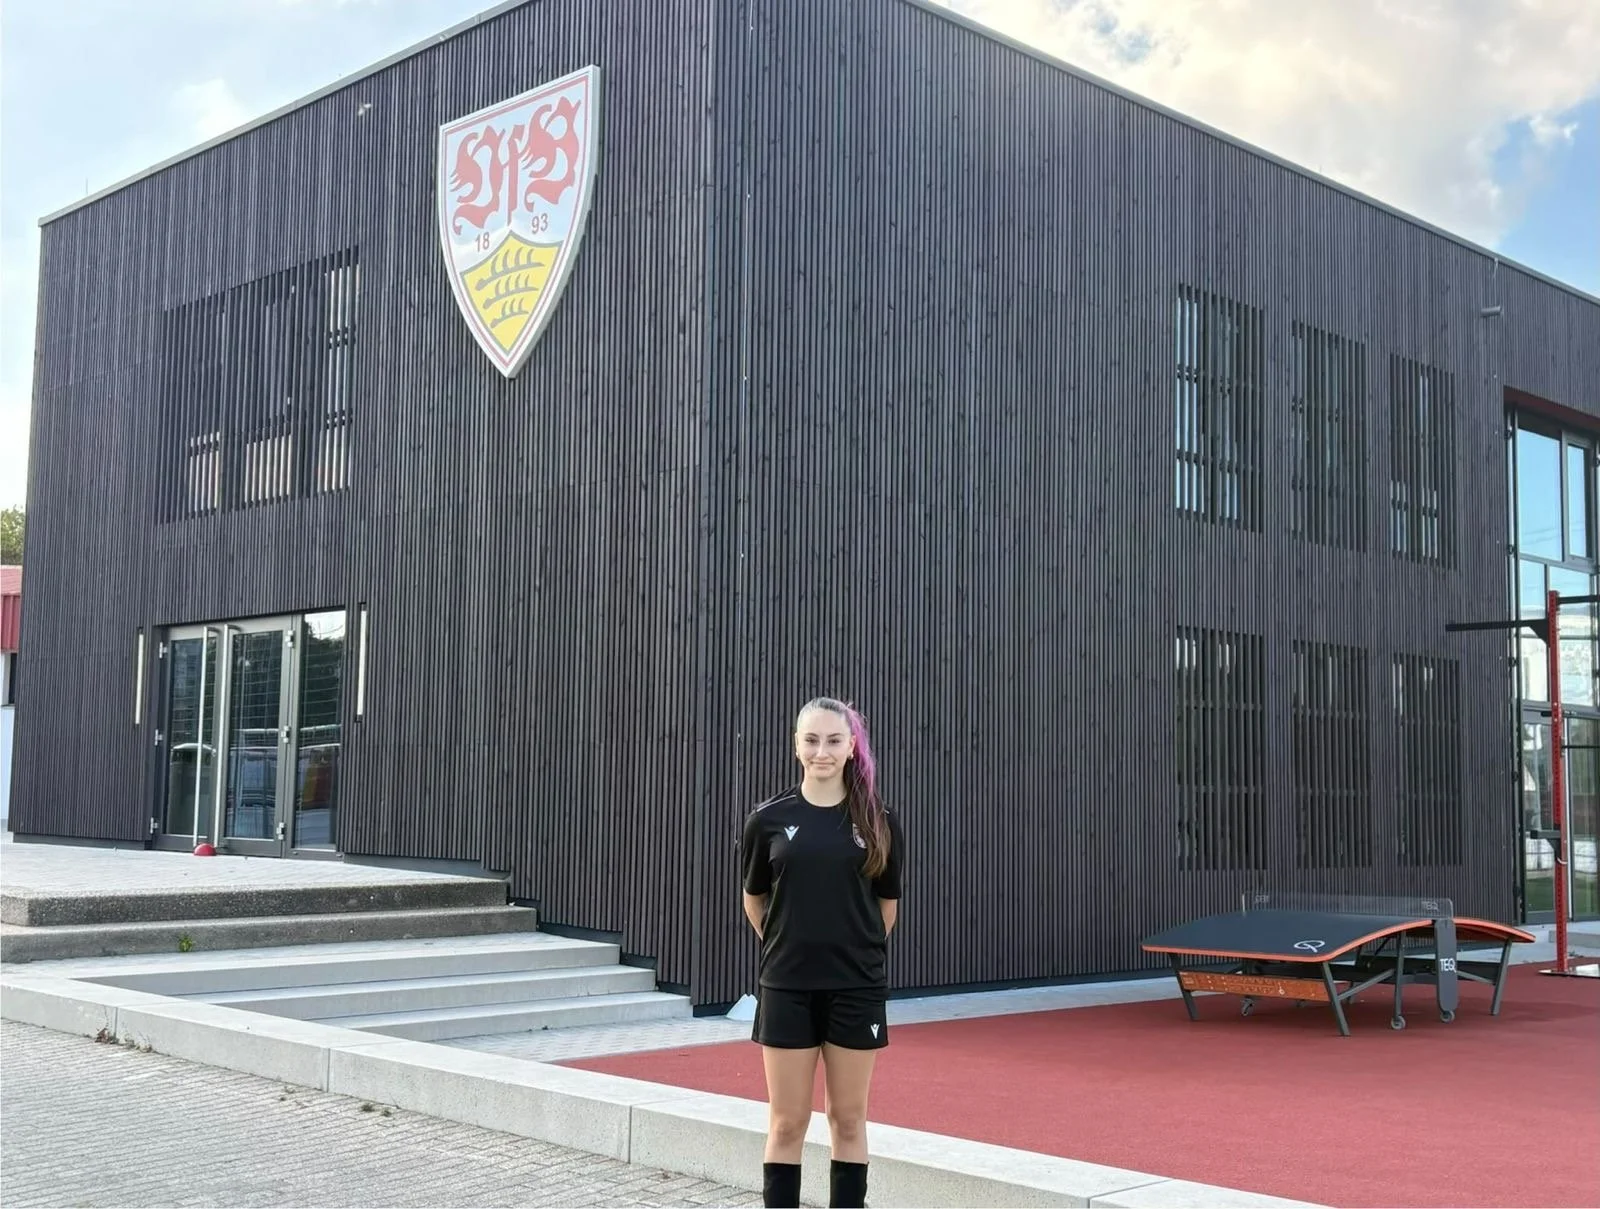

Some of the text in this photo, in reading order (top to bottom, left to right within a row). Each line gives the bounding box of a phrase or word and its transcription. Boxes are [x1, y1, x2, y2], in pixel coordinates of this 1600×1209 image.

[450, 97, 581, 235] VfB
[475, 213, 548, 252] 18 93
[1440, 958, 1457, 973] TEQ
